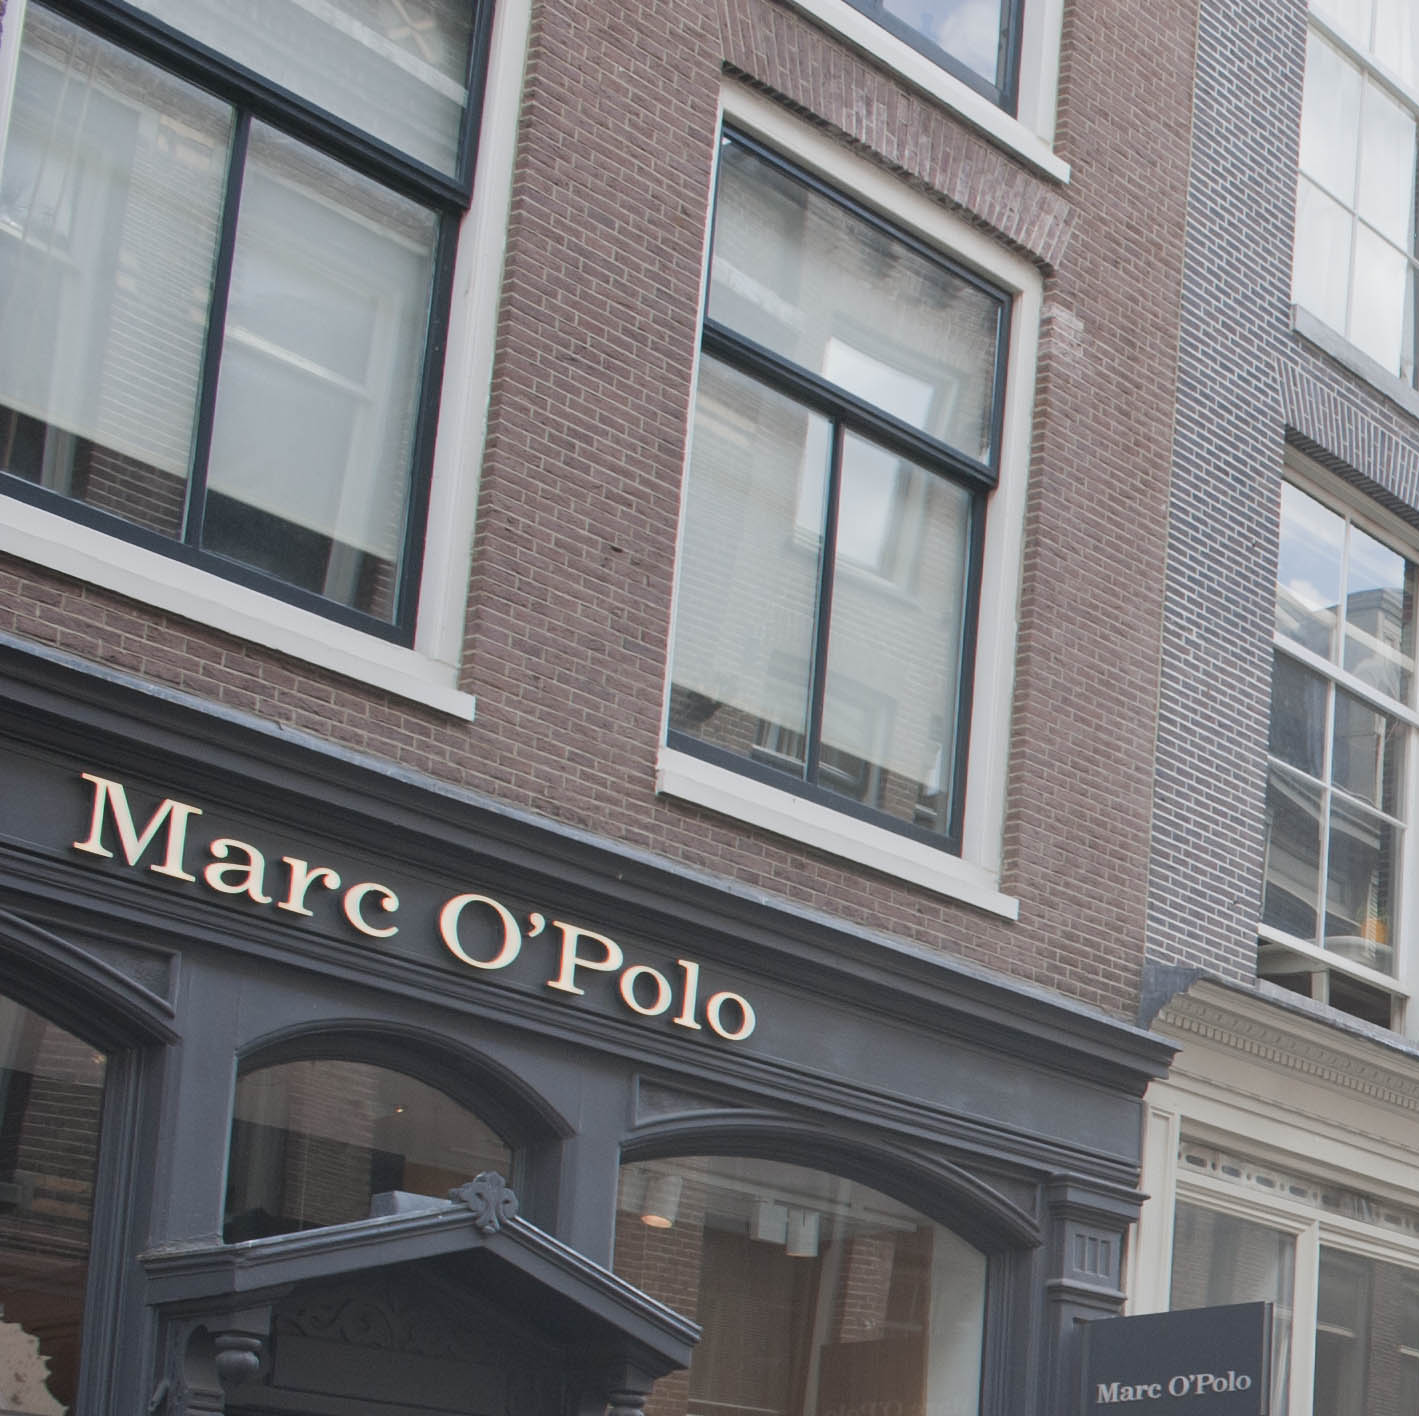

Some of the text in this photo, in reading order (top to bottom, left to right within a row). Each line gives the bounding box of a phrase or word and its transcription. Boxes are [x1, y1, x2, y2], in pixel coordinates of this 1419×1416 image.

[73, 772, 757, 1041] Marc O'Polo
[1096, 1370, 1251, 1404] Marc O'Polo
